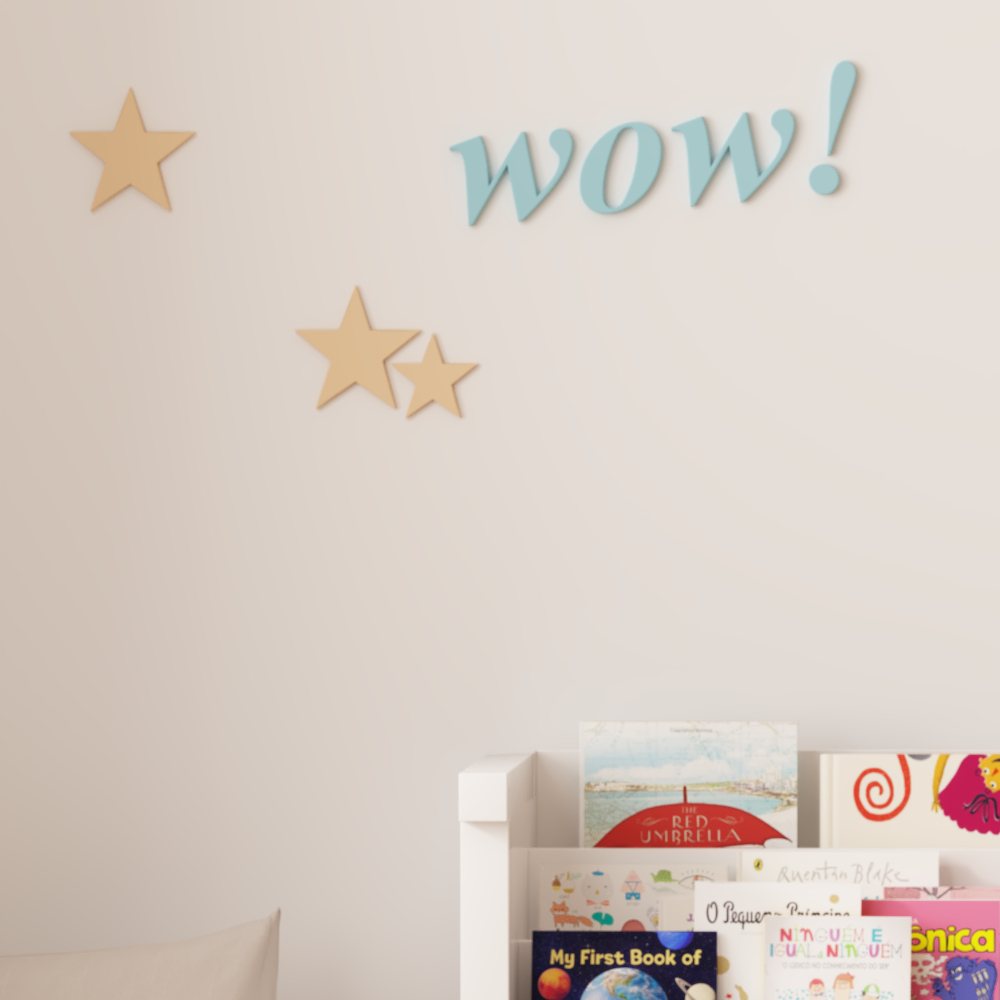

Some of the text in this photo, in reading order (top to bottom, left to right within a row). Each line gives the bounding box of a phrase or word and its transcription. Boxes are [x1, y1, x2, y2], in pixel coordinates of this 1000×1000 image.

[449, 60, 857, 227] wow!
[681, 806, 698, 814] THE
[672, 815, 708, 829] RED
[640, 829, 741, 845] UMBRELLA
[777, 861, 909, 886] Quentin Blake
[706, 901, 719, 924] O
[872, 925, 883, 942] É
[911, 925, 996, 952] ônica
[550, 948, 702, 969] My First Book of
[770, 943, 817, 958] IGUAL
